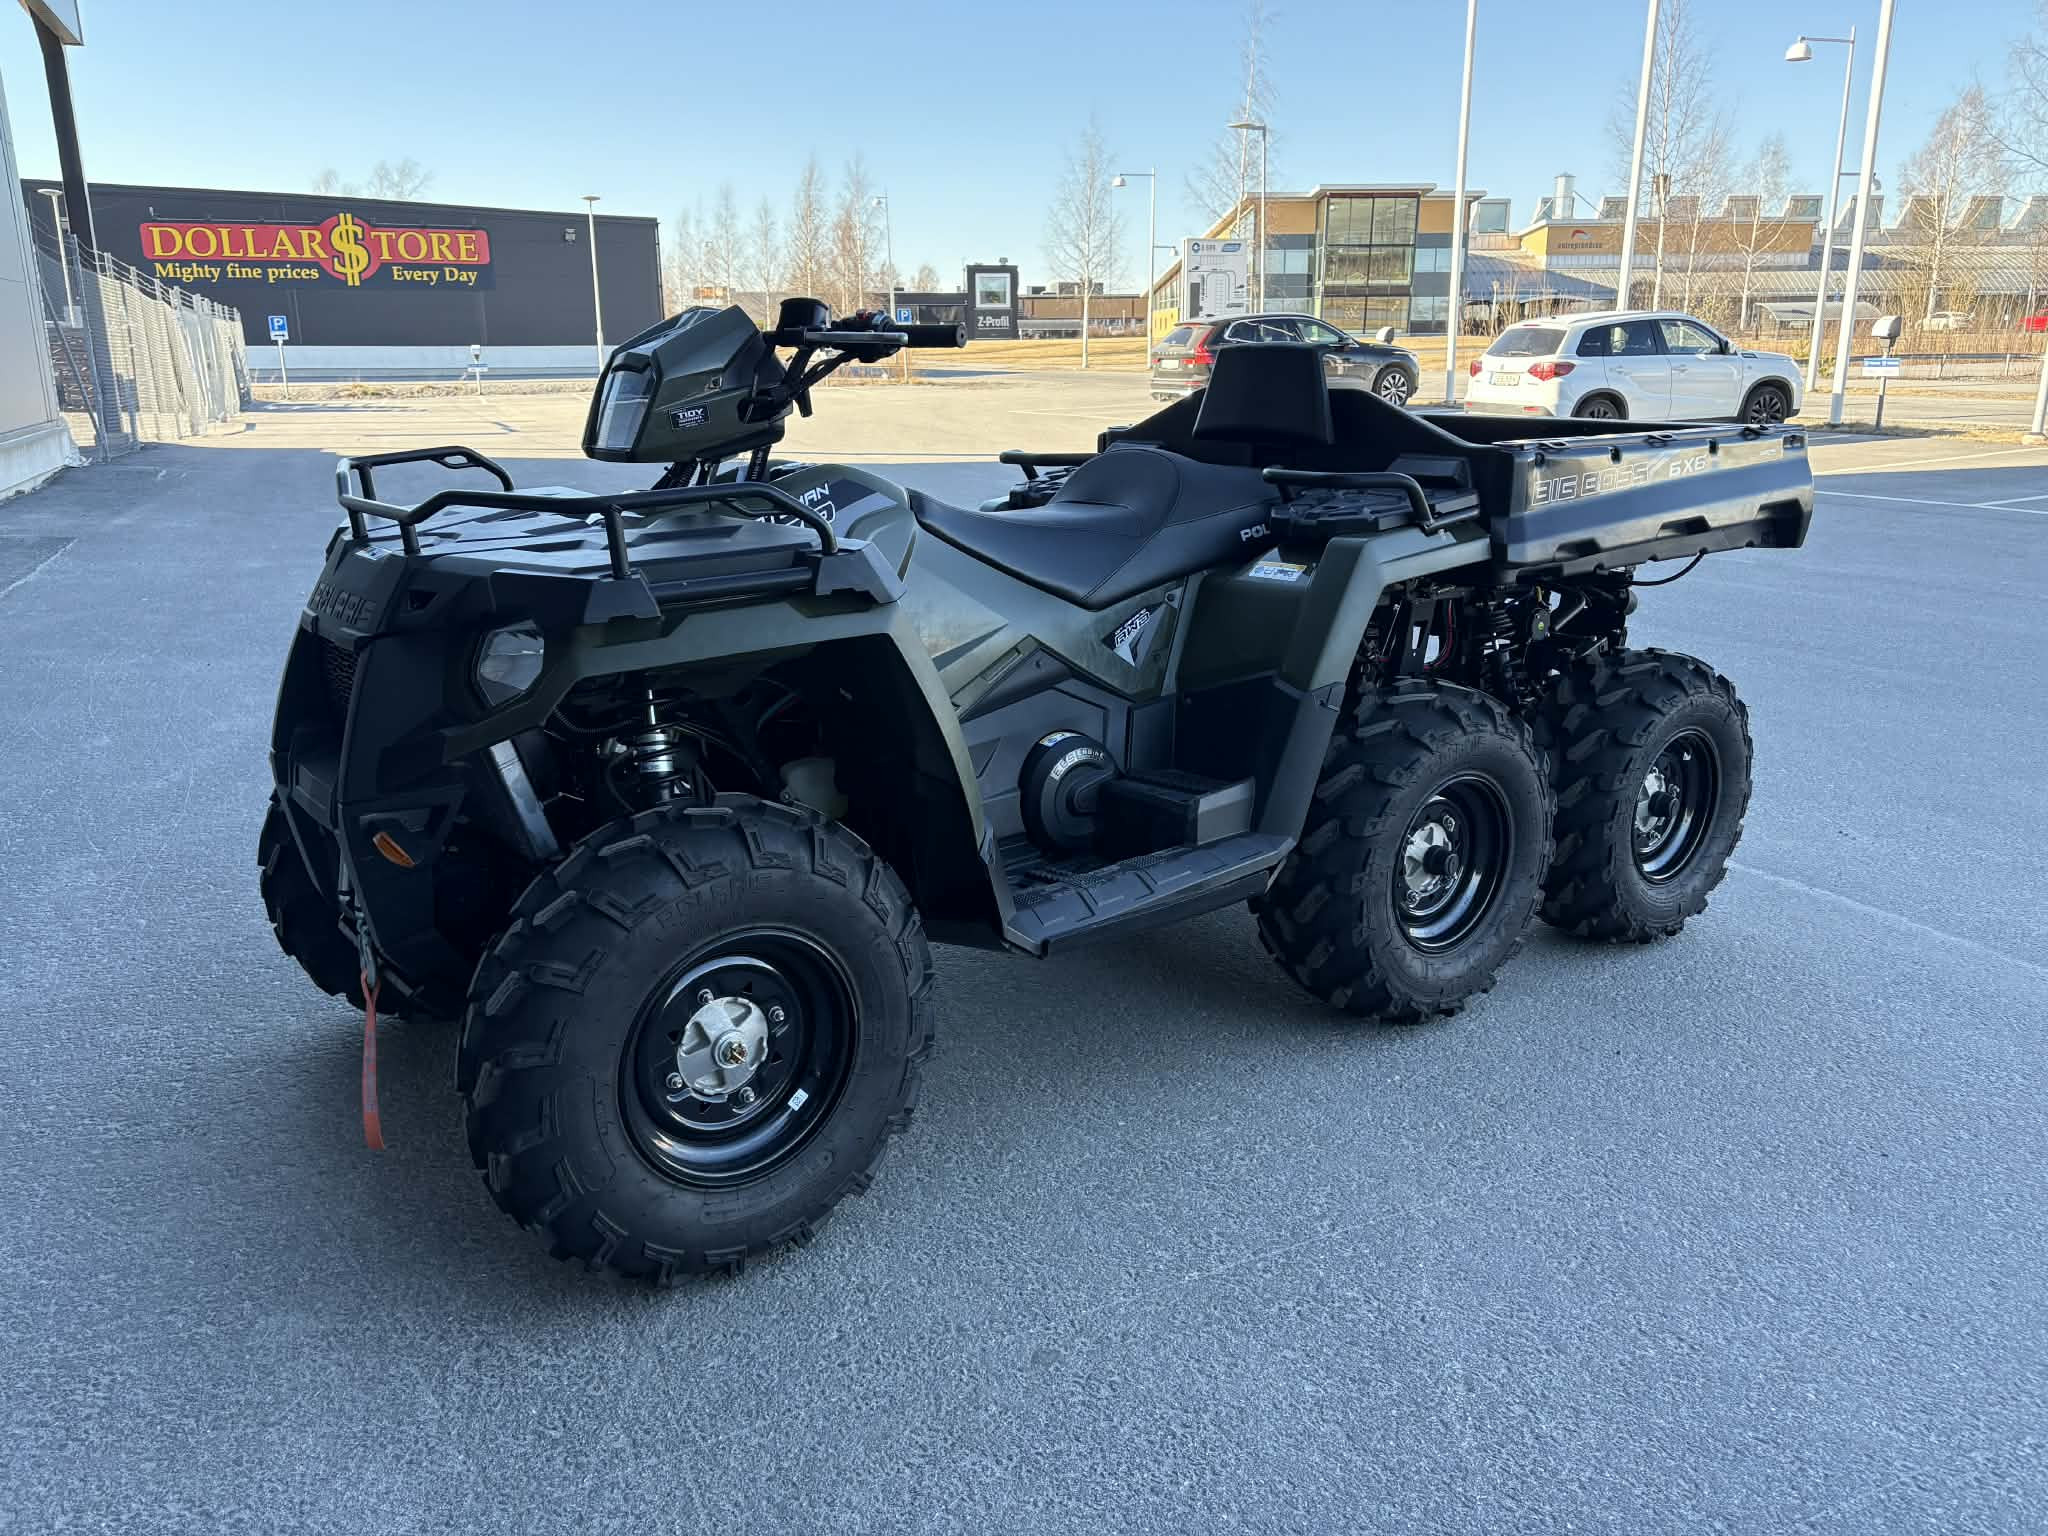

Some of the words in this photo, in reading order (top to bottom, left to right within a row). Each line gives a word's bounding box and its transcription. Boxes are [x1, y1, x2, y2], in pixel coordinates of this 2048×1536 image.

[154, 262, 221, 283] Mighty
[225, 264, 262, 279] fine
[266, 266, 320, 283] prices
[392, 266, 440, 283] Every
[444, 268, 479, 286] Day
[274, 318, 283, 330] P
[976, 316, 1010, 329] Z-Profil
[1532, 474, 1578, 506] BIG
[1581, 461, 1649, 497] BOSS
[1668, 455, 1706, 479] 6X6
